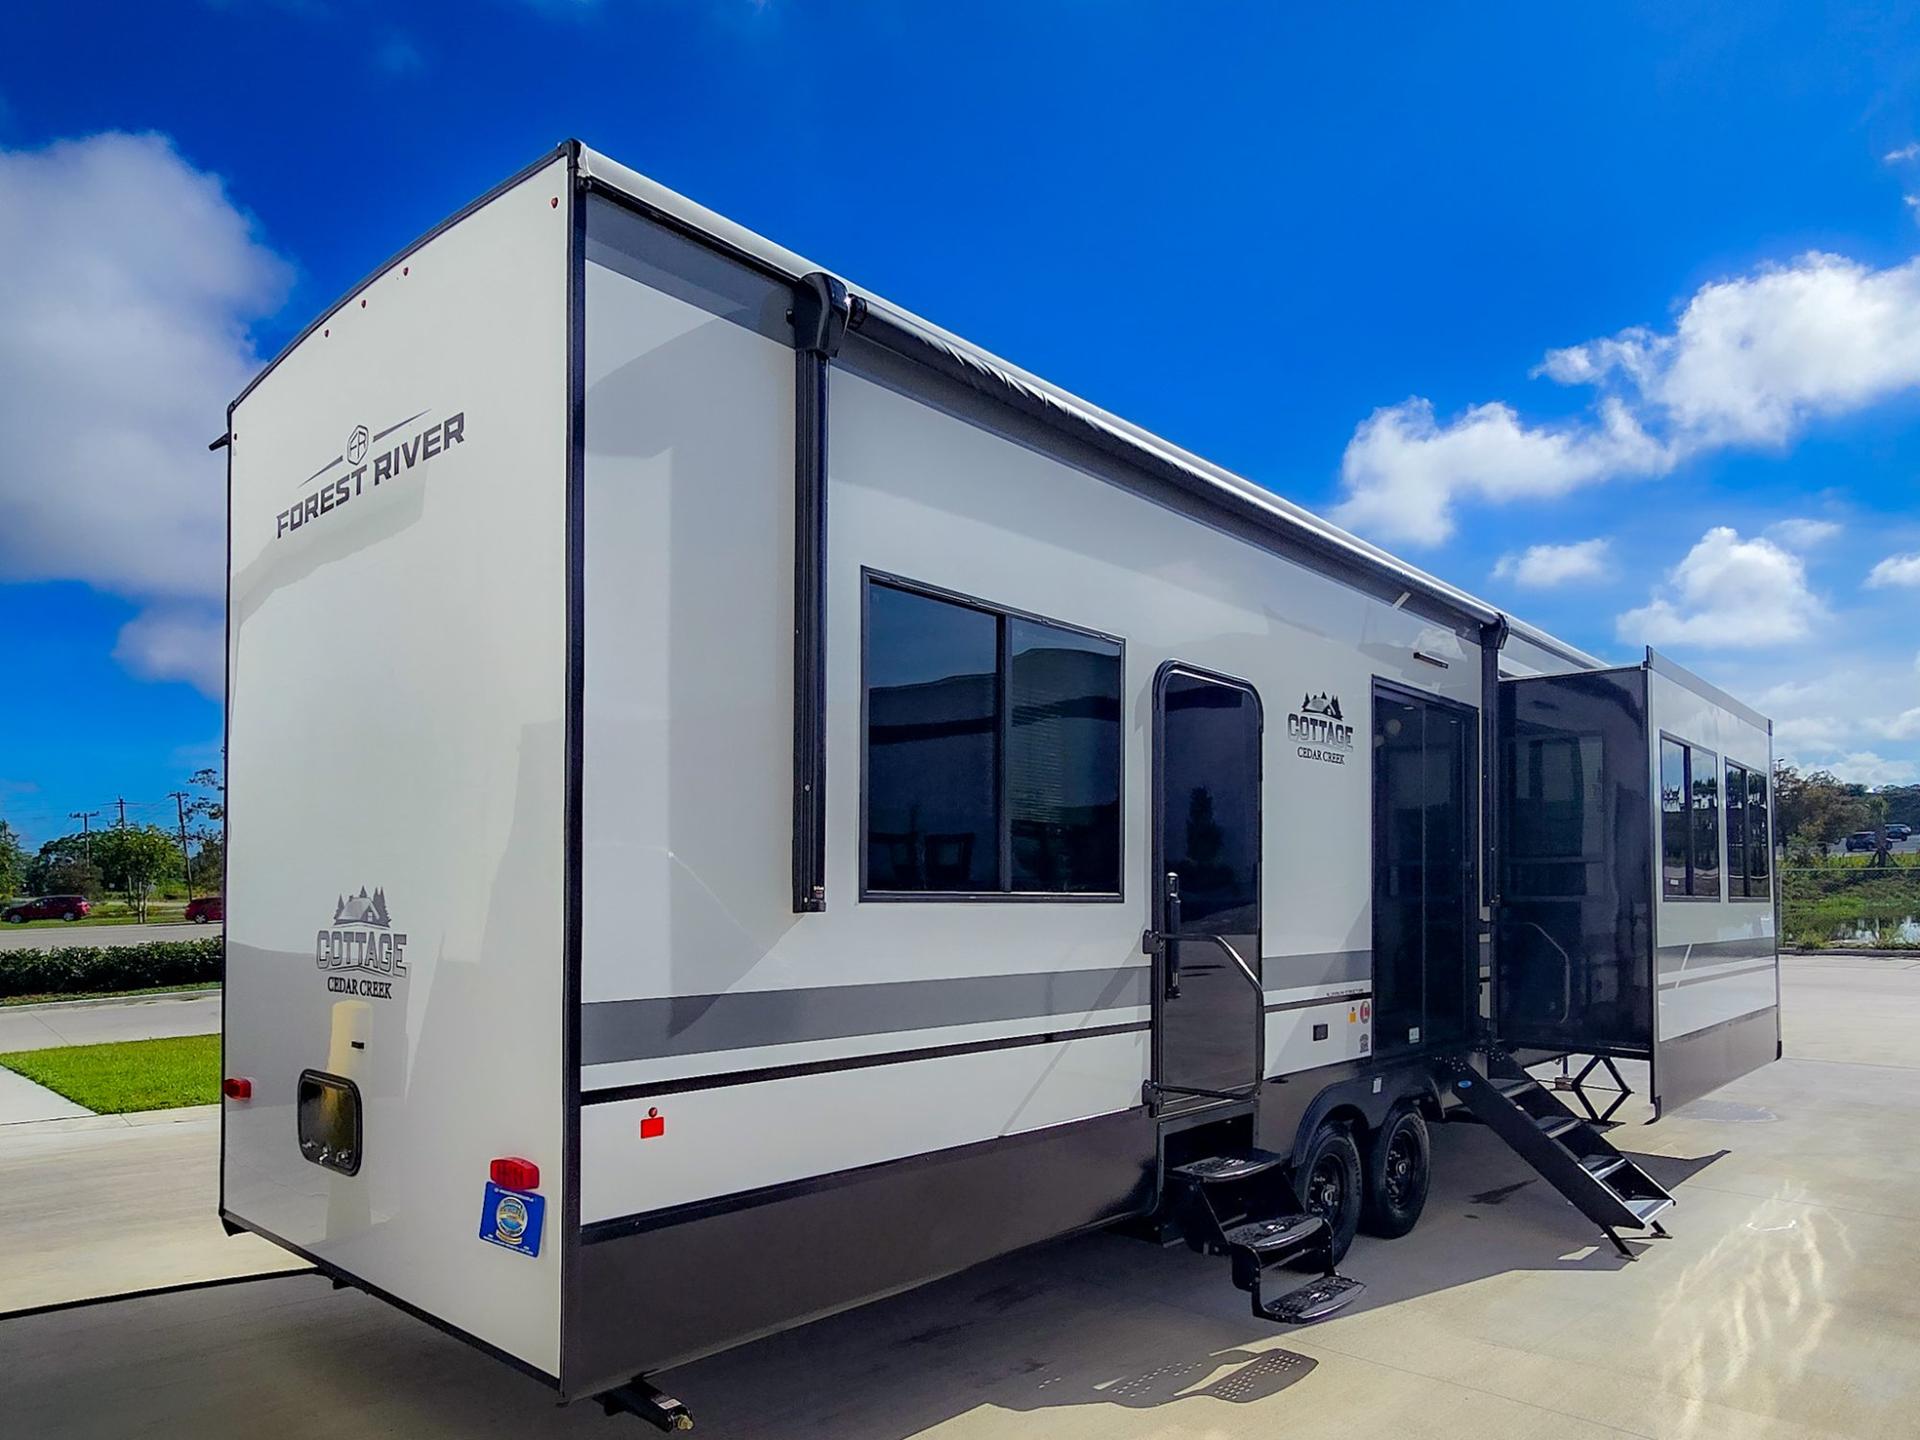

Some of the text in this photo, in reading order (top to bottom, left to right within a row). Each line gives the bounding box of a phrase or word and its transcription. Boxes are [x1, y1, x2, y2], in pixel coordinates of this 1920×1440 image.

[276, 411, 465, 540] FOREST RIVER
[1287, 713, 1354, 753] COTTAGE
[1297, 746, 1345, 765] CEDAR CREEK
[316, 930, 407, 978] COTTAGE
[327, 976, 392, 999] CEDAR CREEK
